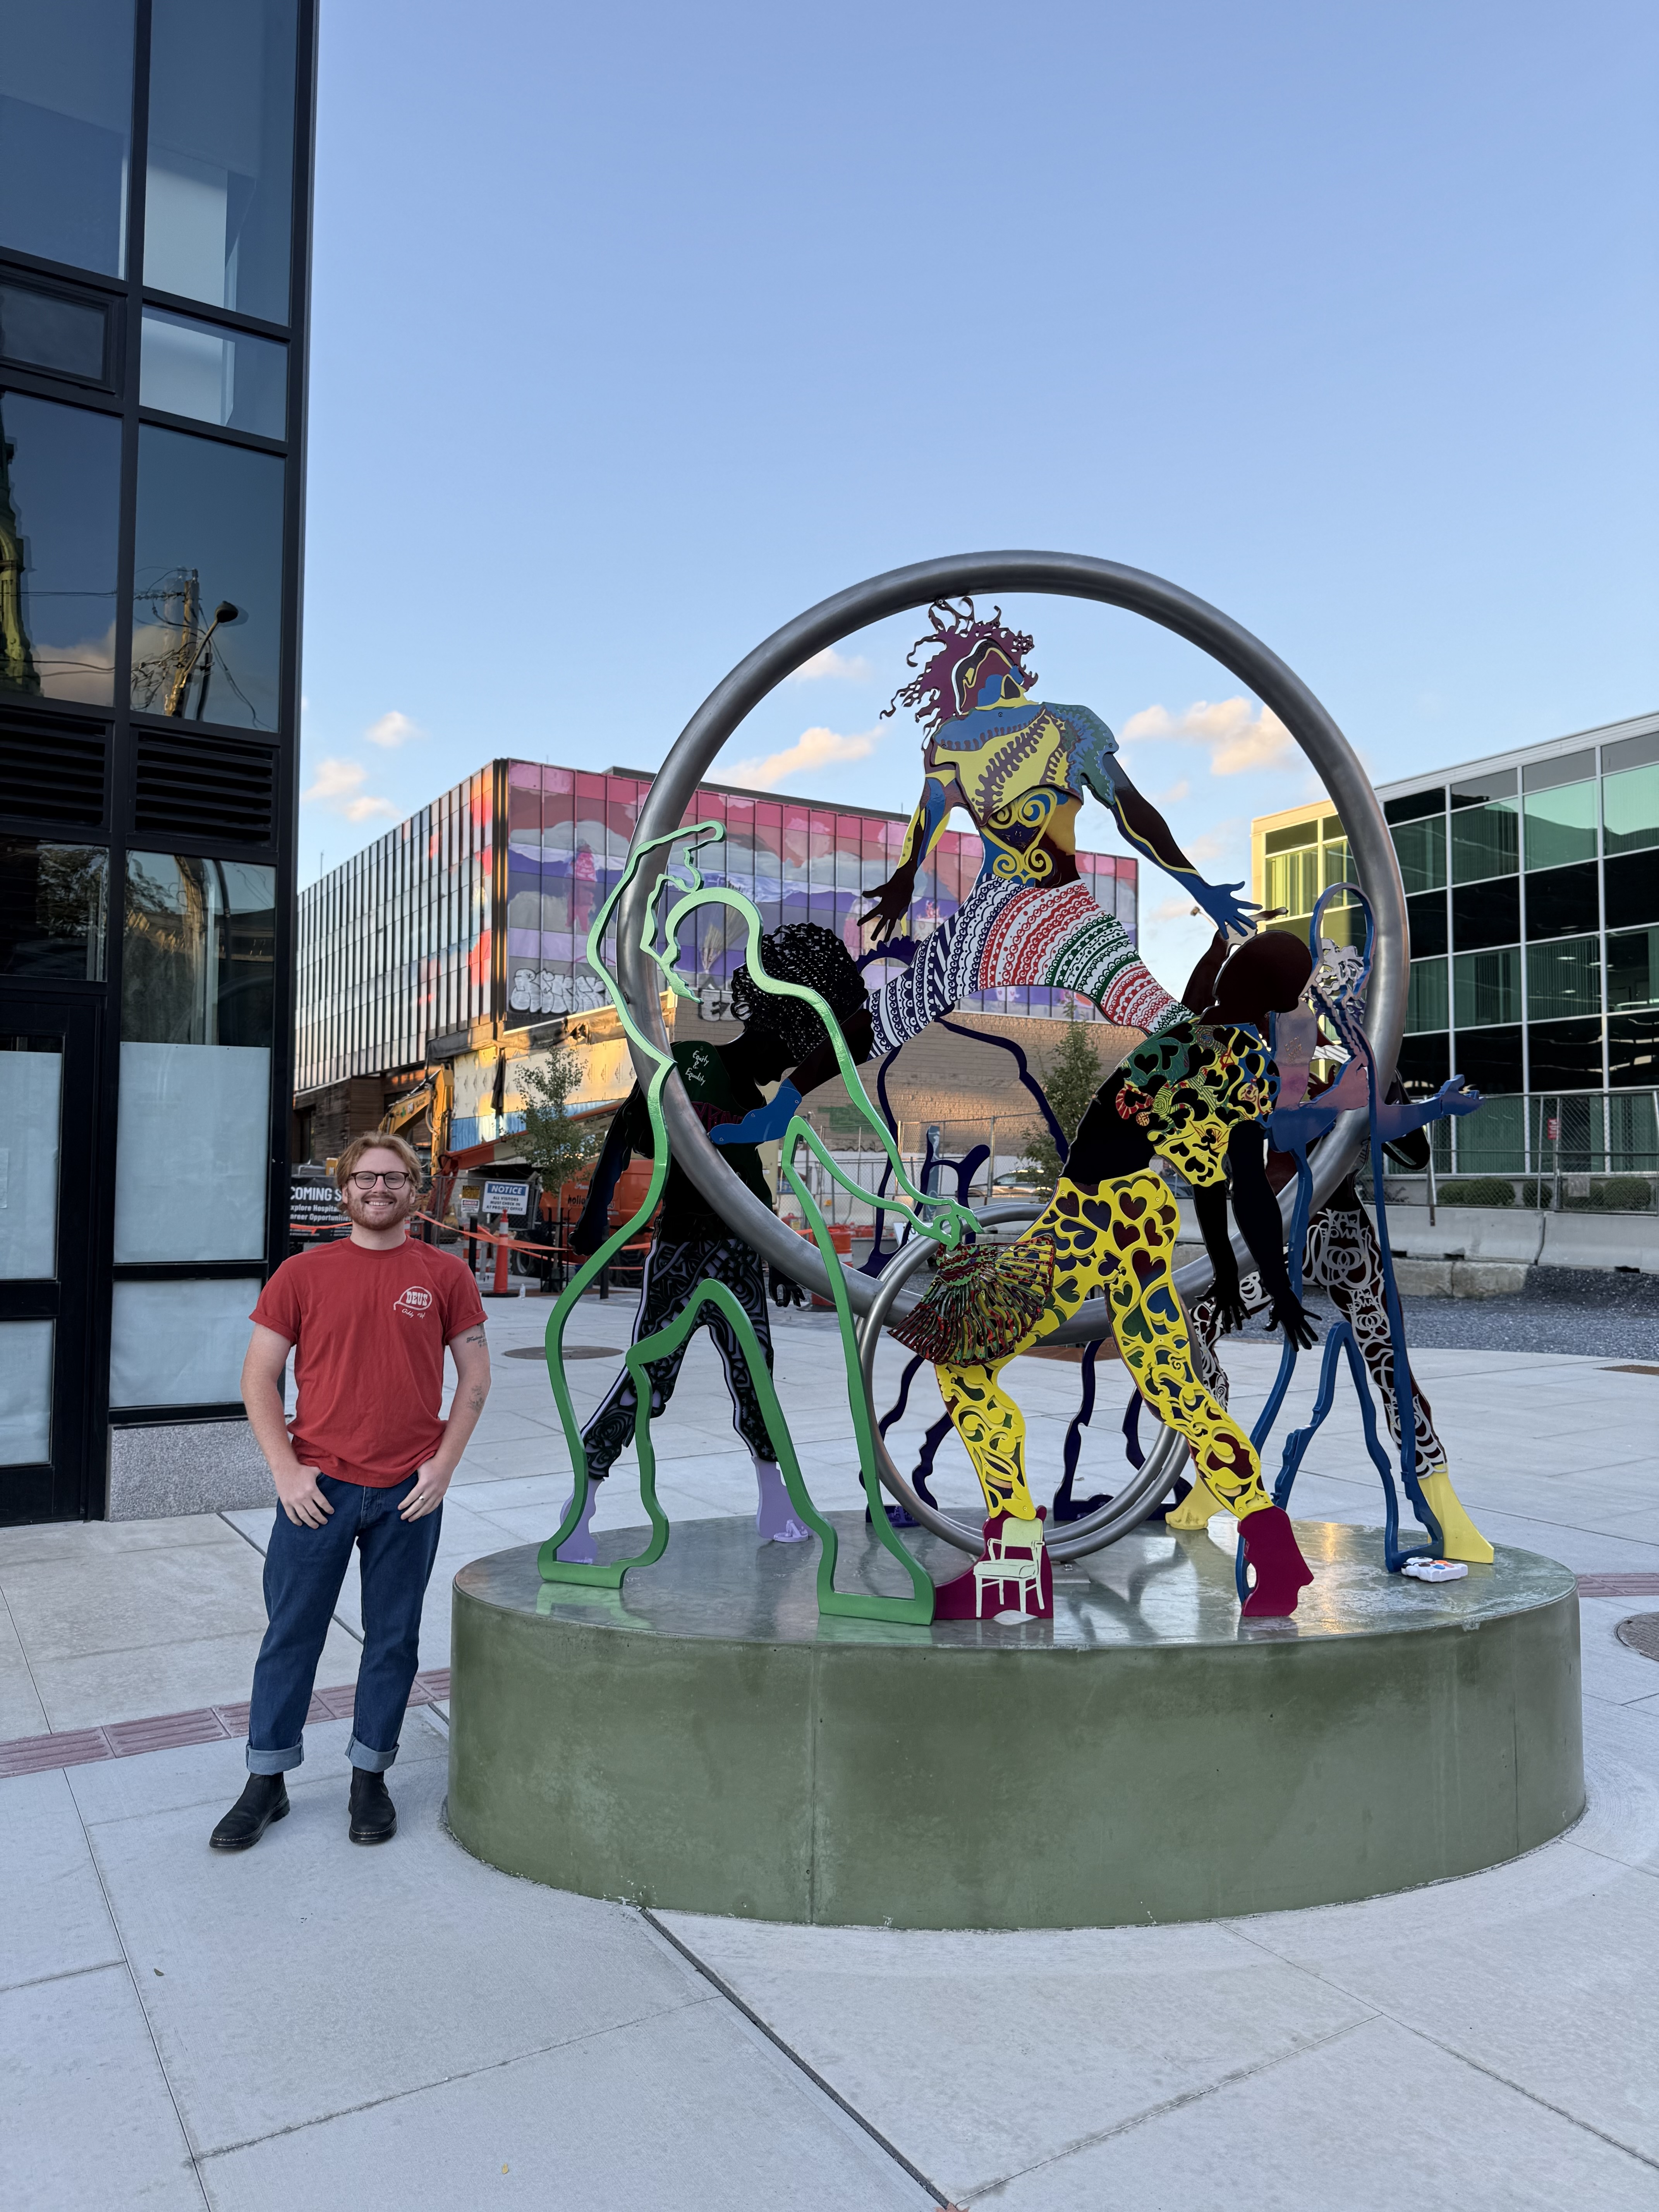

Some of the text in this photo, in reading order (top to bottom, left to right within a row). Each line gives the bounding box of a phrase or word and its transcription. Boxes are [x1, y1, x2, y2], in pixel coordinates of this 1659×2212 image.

[692, 1050, 709, 1066] Equity
[685, 1067, 706, 1086] Equality
[491, 1185, 522, 1194] NOTICE
[290, 1204, 311, 1212] xplore
[406, 1291, 428, 1306] DEUS
[402, 1309, 414, 1318] Giddy
